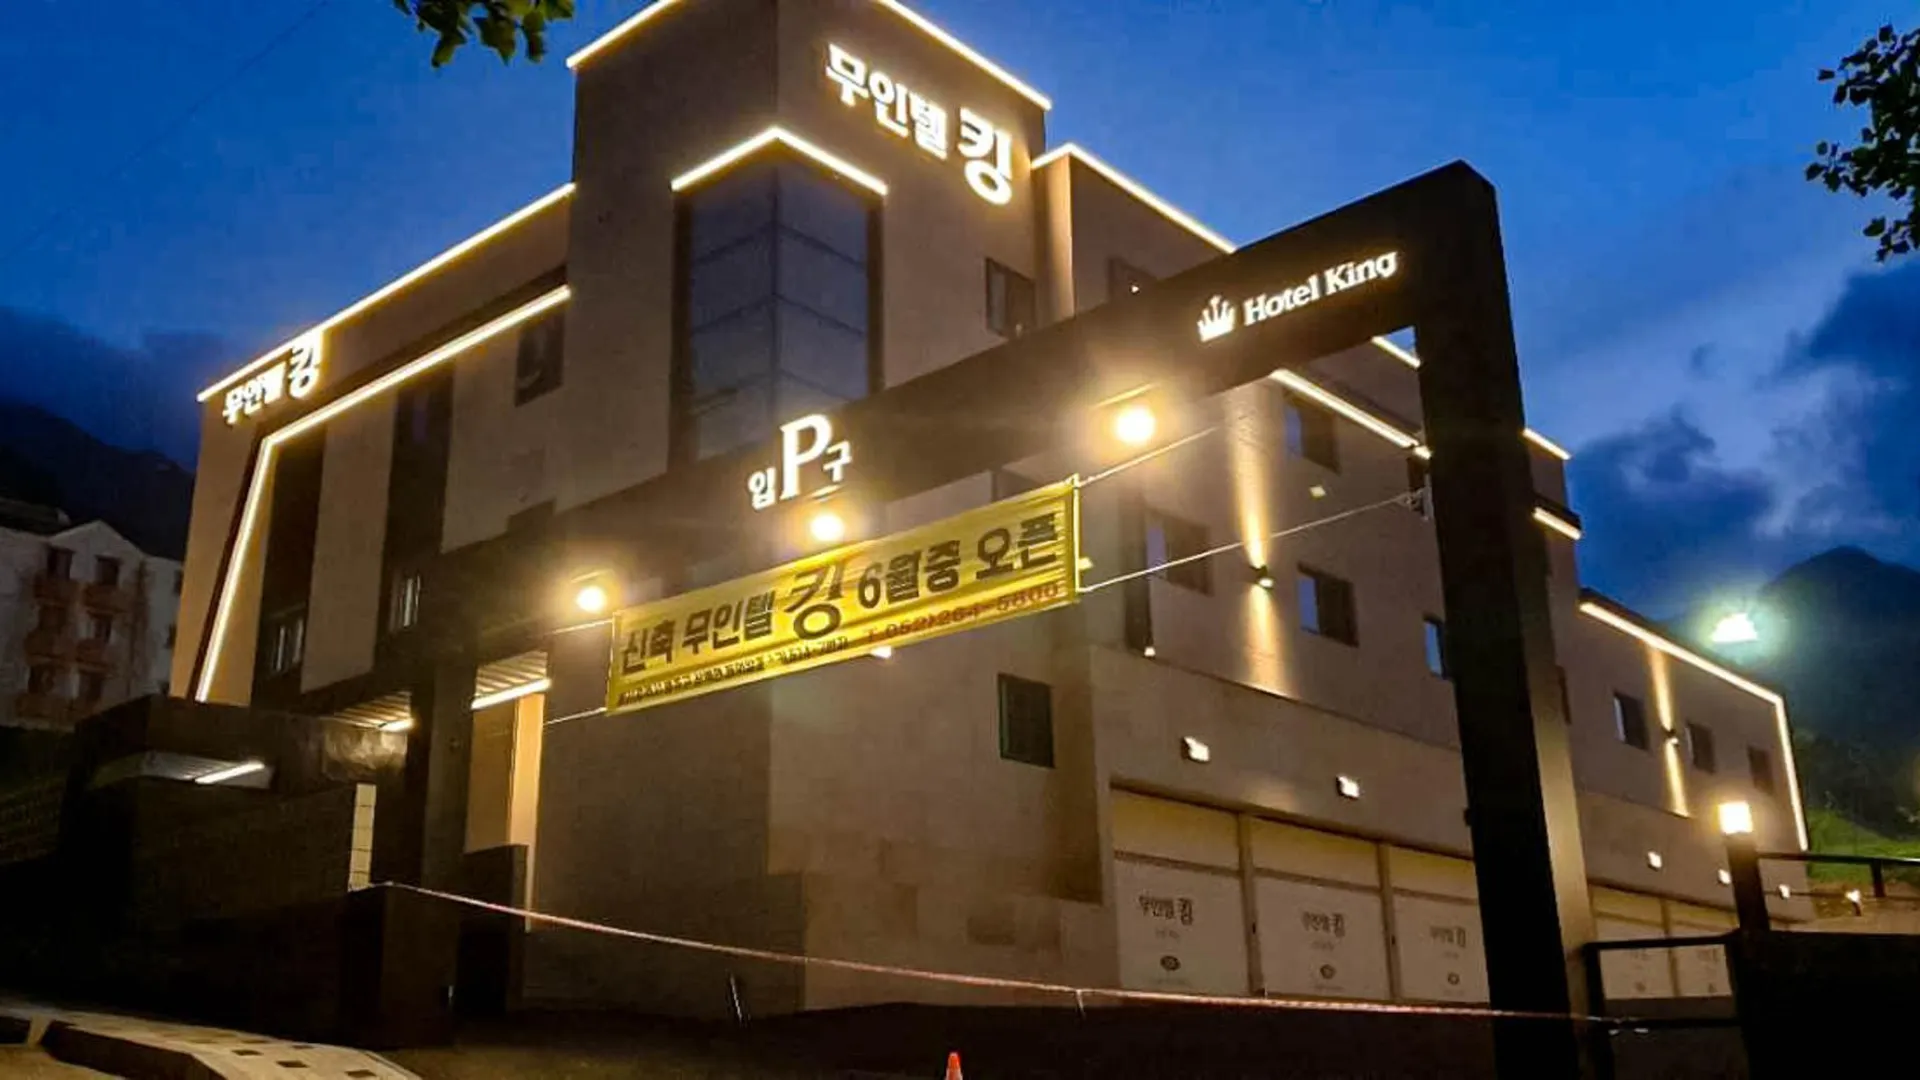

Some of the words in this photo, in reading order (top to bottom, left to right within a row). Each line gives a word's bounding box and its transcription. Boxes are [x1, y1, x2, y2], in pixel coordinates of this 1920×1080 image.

[826, 43, 947, 160] 무인텔
[957, 107, 1014, 206] 킹
[1243, 273, 1320, 327] Hotel
[1323, 251, 1399, 296] King
[222, 360, 286, 425] 무인텔
[287, 333, 322, 399] 킹
[620, 623, 676, 675] 신축
[682, 590, 777, 656] 무인텔
[784, 561, 848, 641] 킹
[857, 539, 961, 611] 6월중
[976, 512, 1058, 581] 오픈
